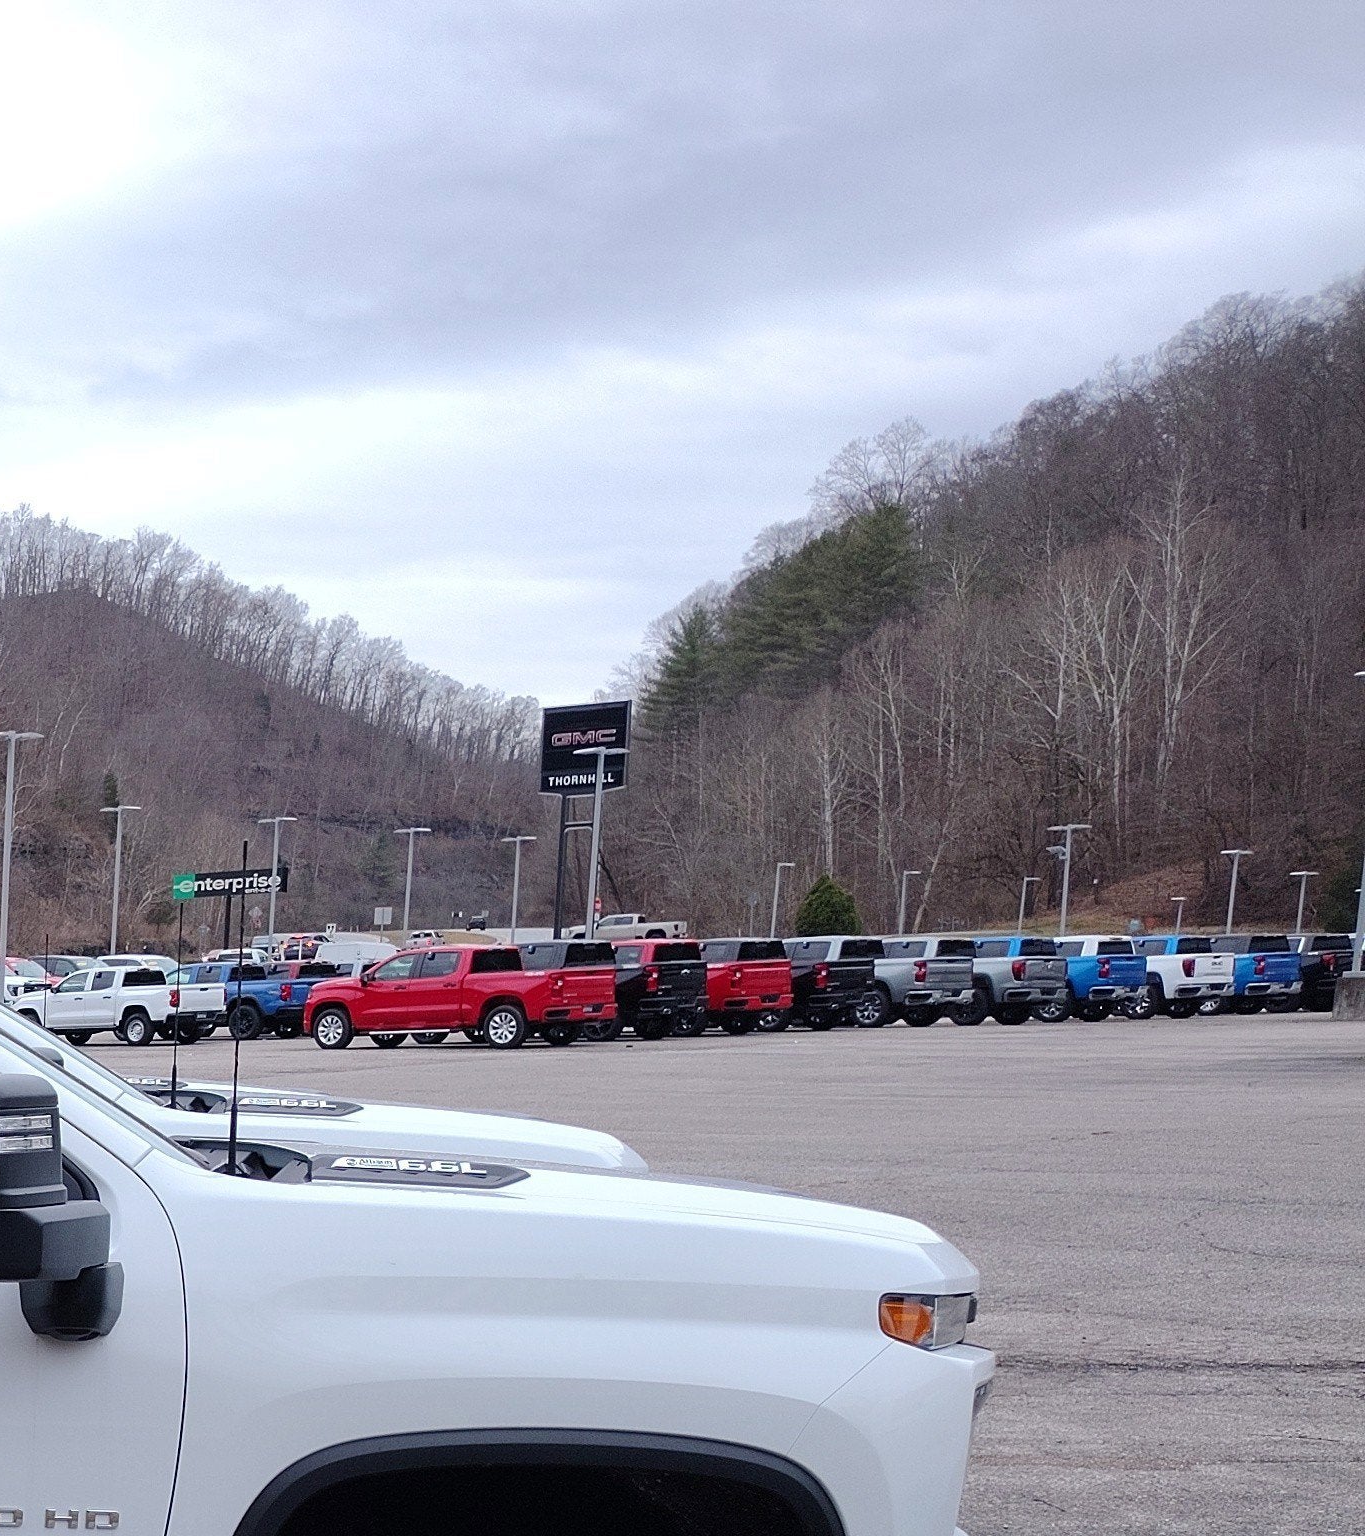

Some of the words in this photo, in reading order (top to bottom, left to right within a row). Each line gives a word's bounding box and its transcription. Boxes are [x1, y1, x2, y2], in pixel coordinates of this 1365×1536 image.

[551, 728, 617, 747] GMC
[548, 772, 615, 787] THORNHLL
[397, 1159, 487, 1175] 6.6L
[44, 1508, 120, 1530] HD
